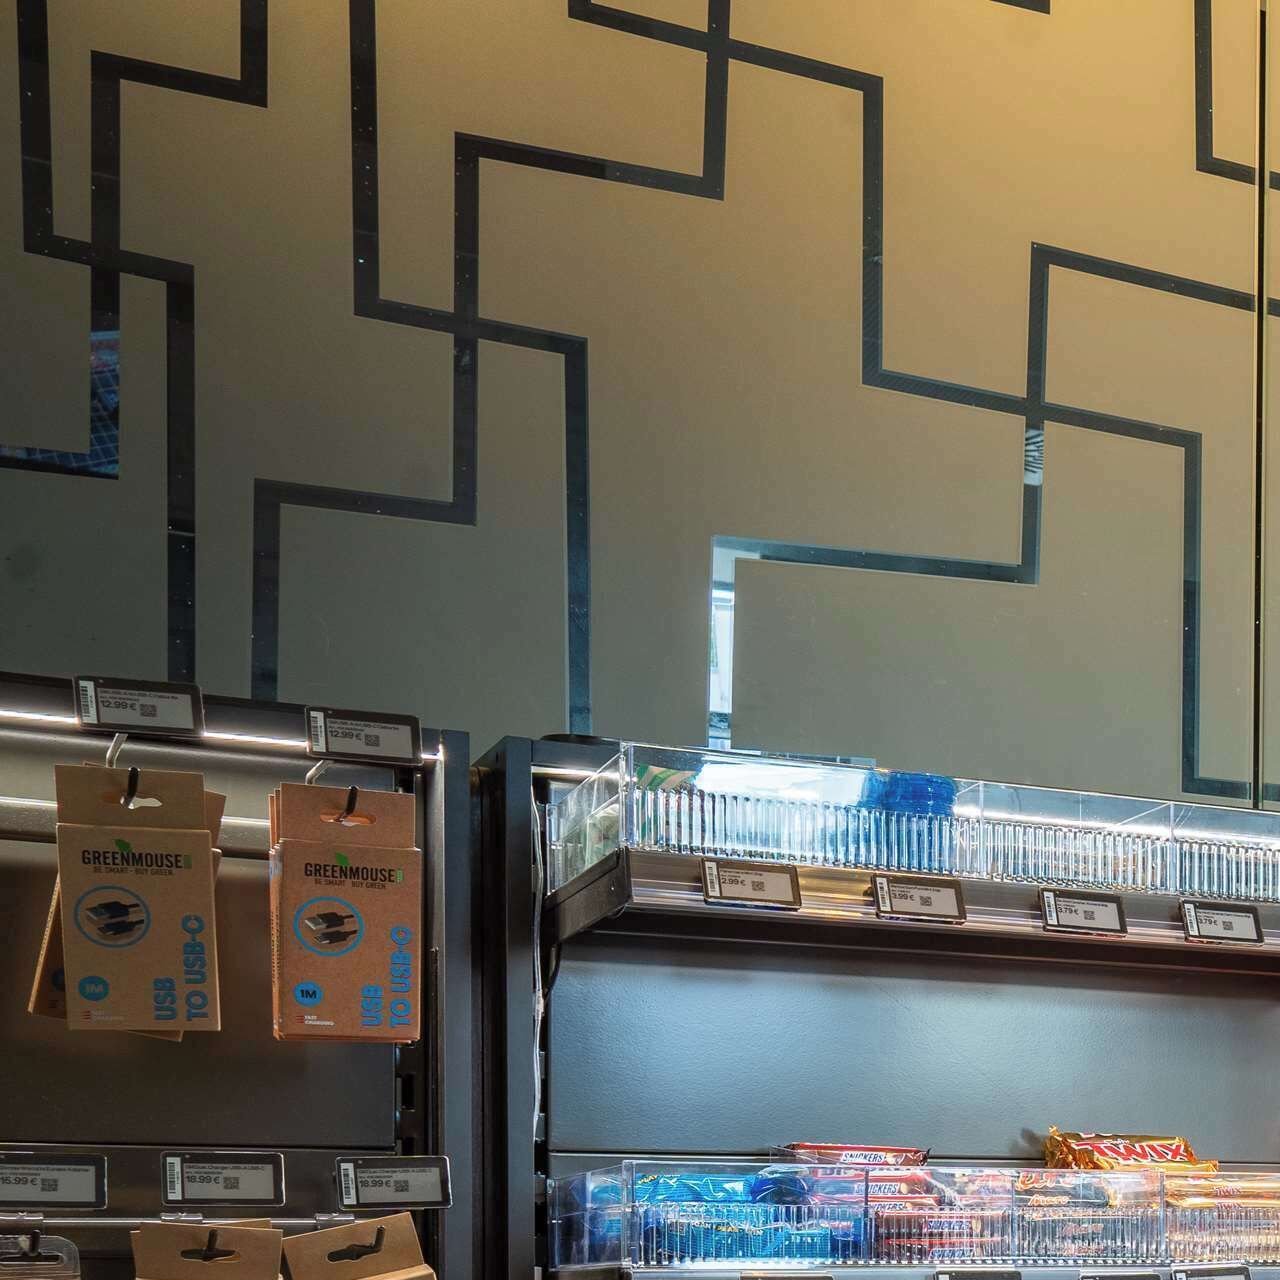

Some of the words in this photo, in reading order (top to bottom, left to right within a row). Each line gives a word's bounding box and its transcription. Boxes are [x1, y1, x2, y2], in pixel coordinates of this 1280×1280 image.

[354, 731, 362, 741] €
[81, 849, 183, 869] GREENMOUSE
[304, 862, 395, 883] GREENMOUSE
[181, 914, 206, 985] USB-C
[391, 926, 412, 993] USB-C
[153, 976, 176, 1021] USB
[300, 989, 317, 999] 1M
[186, 990, 209, 1021] TO
[361, 983, 383, 1027] USB
[389, 998, 411, 1028] TO
[843, 1150, 887, 1164] SNICKERS
[1072, 1141, 1189, 1163] TWIX
[213, 1176, 220, 1185] €
[385, 1180, 392, 1189] €
[1215, 1186, 1241, 1196] TWIX
